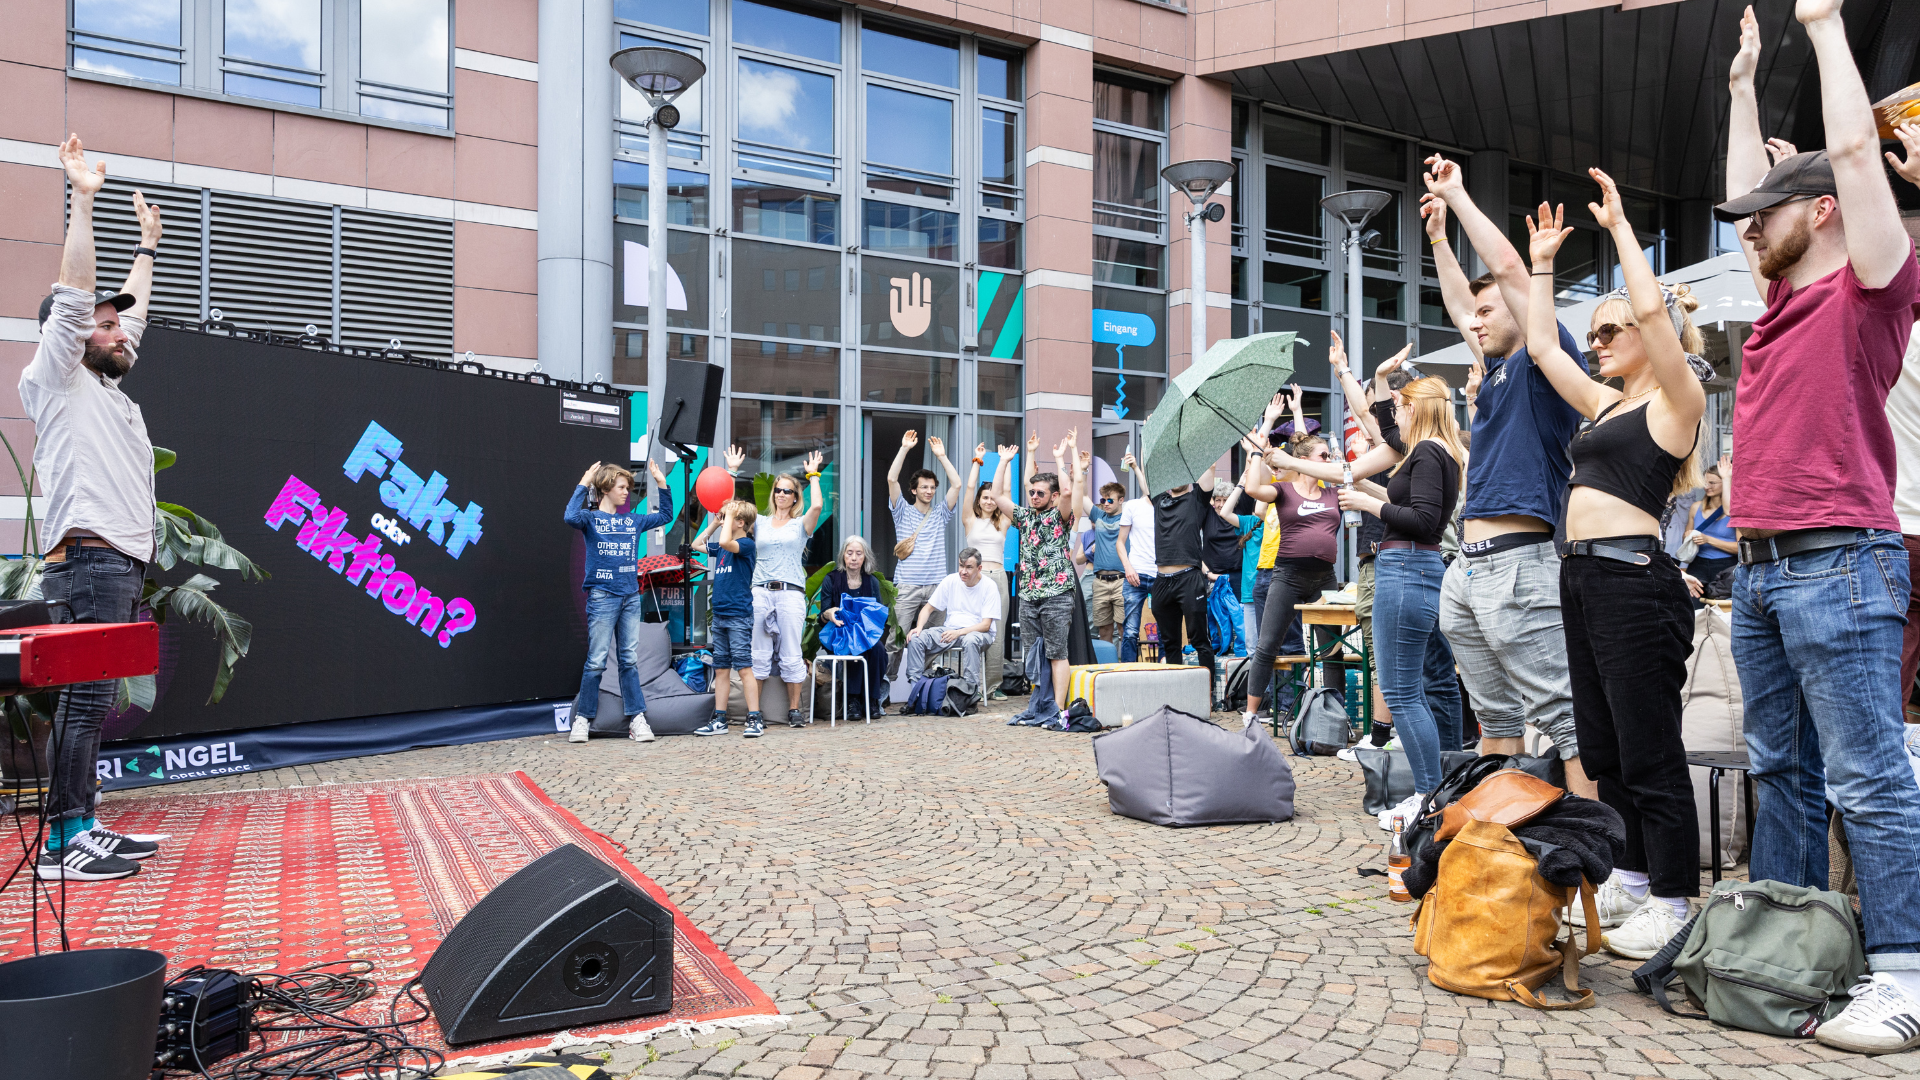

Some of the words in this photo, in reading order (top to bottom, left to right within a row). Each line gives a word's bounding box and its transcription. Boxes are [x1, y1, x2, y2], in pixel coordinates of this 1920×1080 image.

[1104, 322, 1138, 336] Eingang
[342, 420, 484, 560] Fakt
[370, 512, 411, 546] oder
[597, 542, 618, 550] OTHER
[264, 474, 476, 648] Fiktion?
[596, 572, 614, 580] DATA
